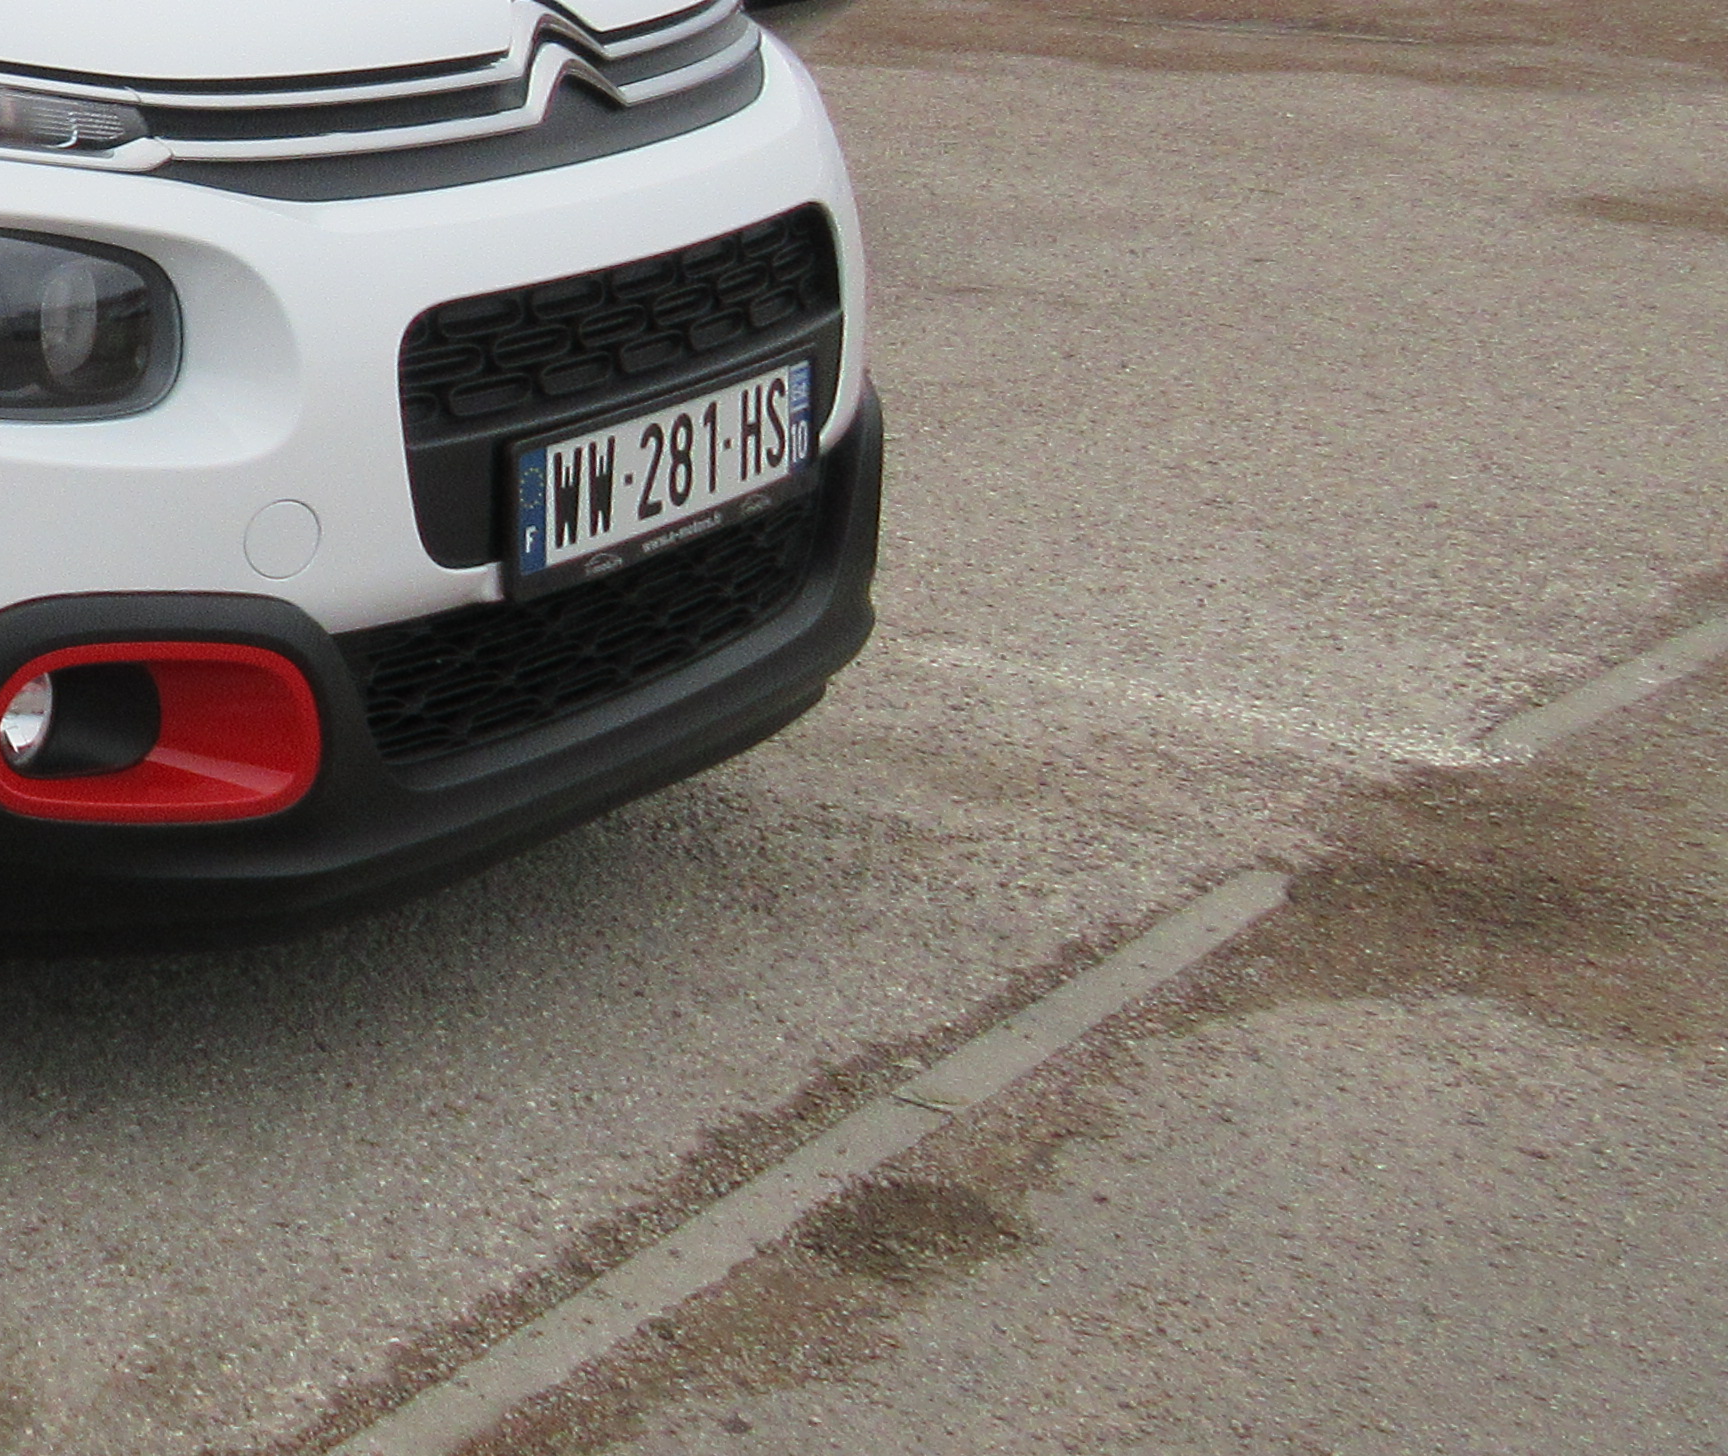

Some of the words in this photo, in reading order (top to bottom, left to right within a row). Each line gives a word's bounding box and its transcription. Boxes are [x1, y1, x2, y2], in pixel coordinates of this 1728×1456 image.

[791, 420, 808, 463] 10
[553, 378, 786, 550] WW-281-HS
[524, 524, 538, 554] F
